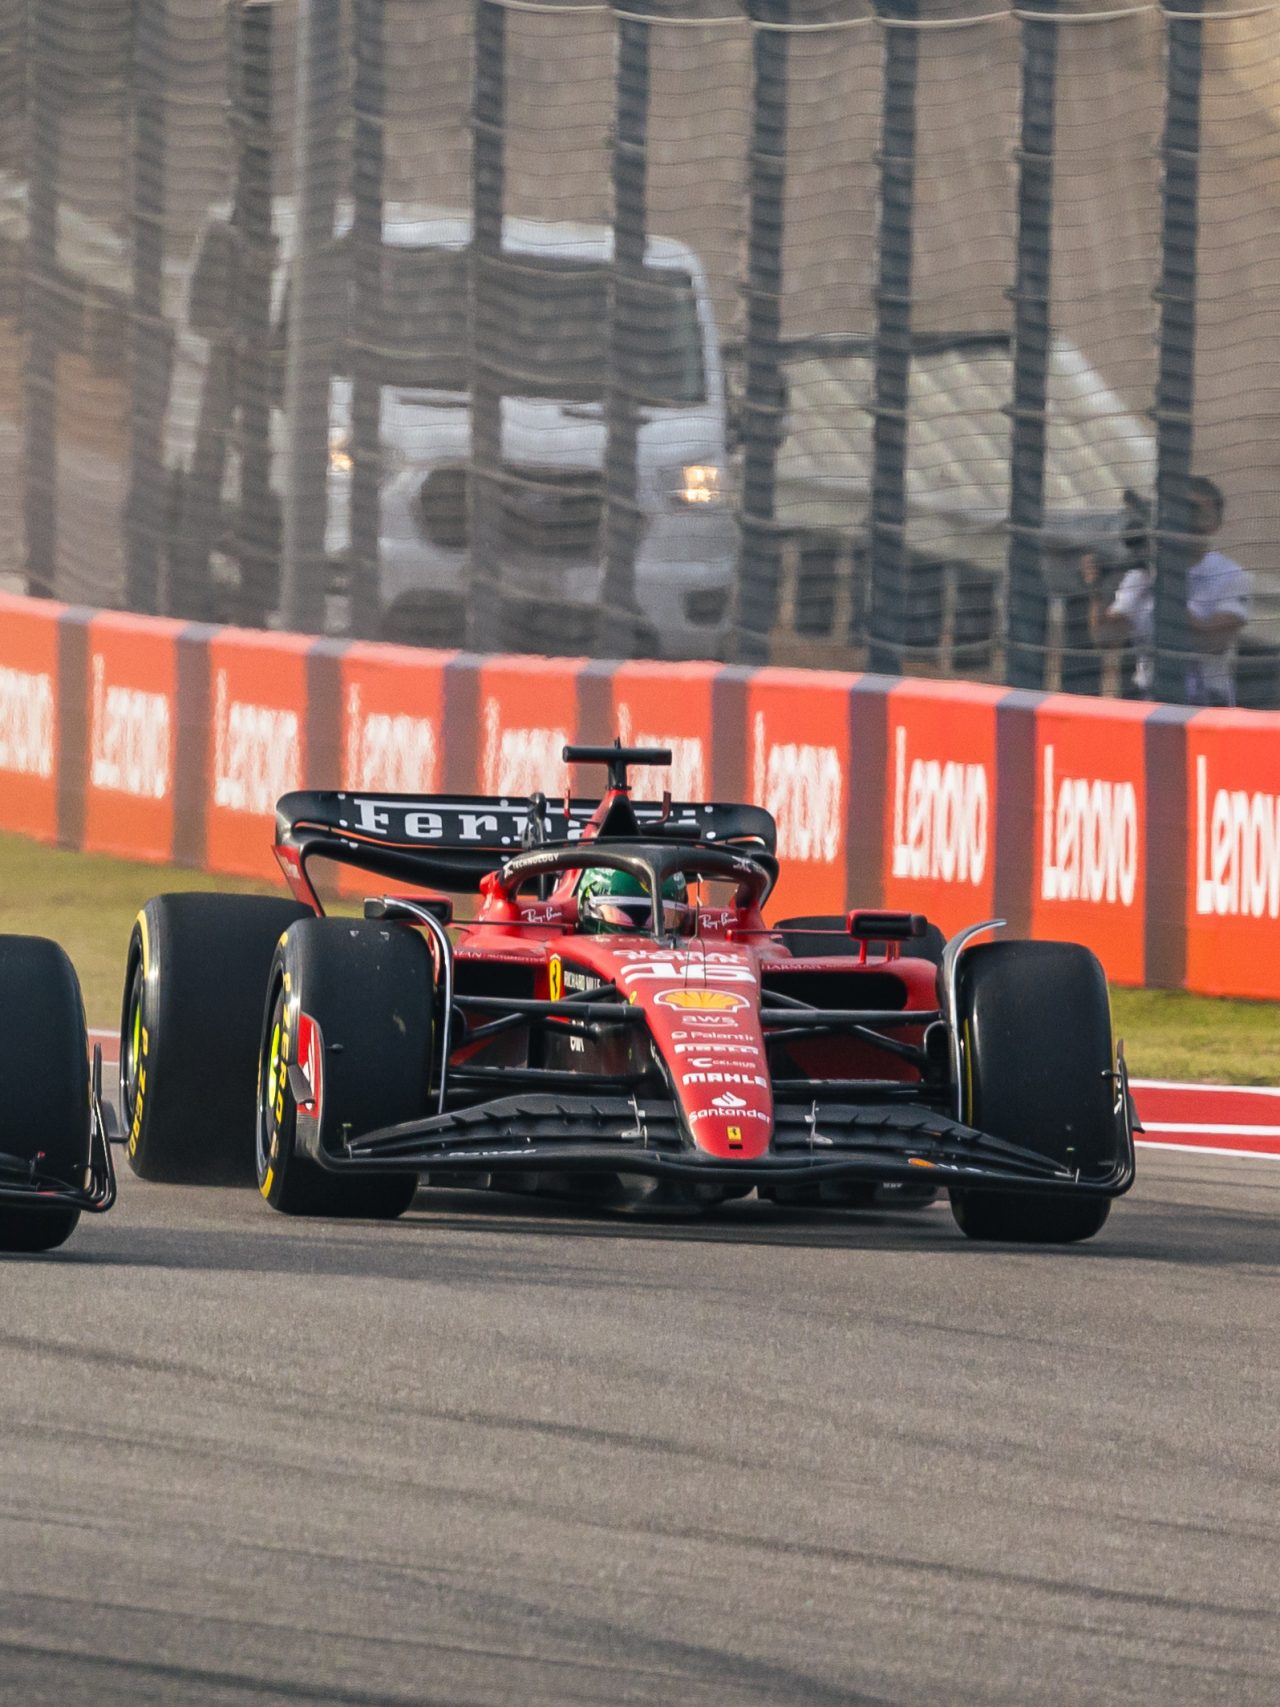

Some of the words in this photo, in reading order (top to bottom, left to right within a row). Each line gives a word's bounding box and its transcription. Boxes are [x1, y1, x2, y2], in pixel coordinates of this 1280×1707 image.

[892, 725, 989, 887] Lenovo
[1040, 743, 1139, 907] Lenovo
[1196, 754, 1280, 919] Lenov
[682, 1072, 767, 1088] MAHLE
[689, 1107, 771, 1123] Santander
